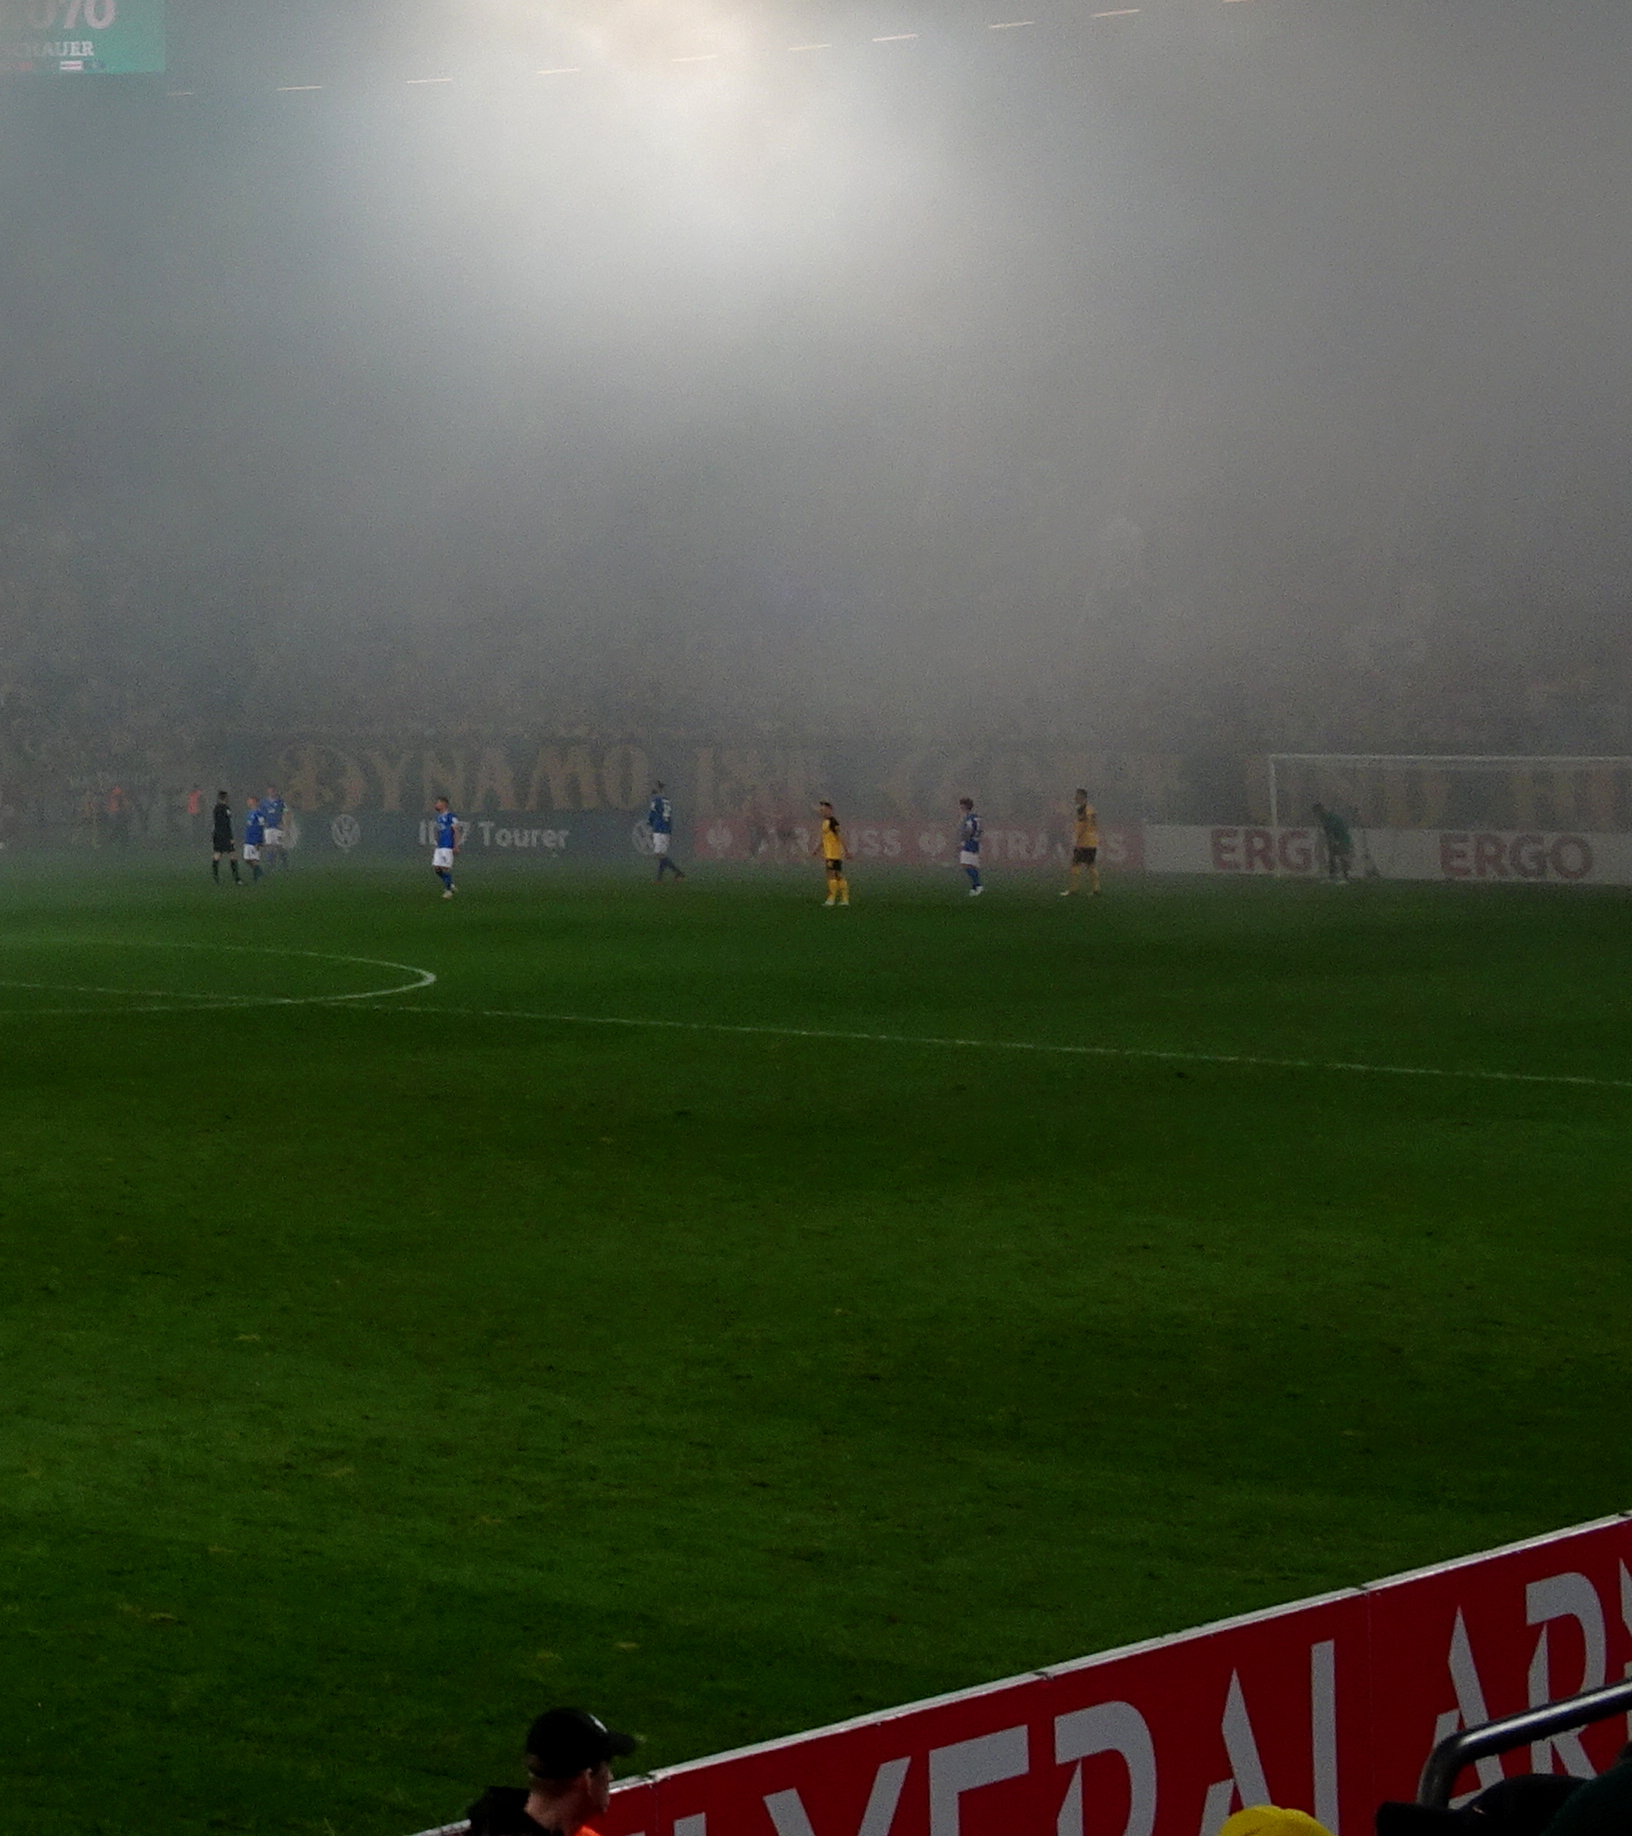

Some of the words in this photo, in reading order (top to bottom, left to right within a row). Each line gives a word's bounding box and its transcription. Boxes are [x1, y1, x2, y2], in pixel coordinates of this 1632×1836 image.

[478, 820, 572, 848] Tourer
[1210, 828, 1322, 872] ERG
[1439, 832, 1595, 880] ERGO
